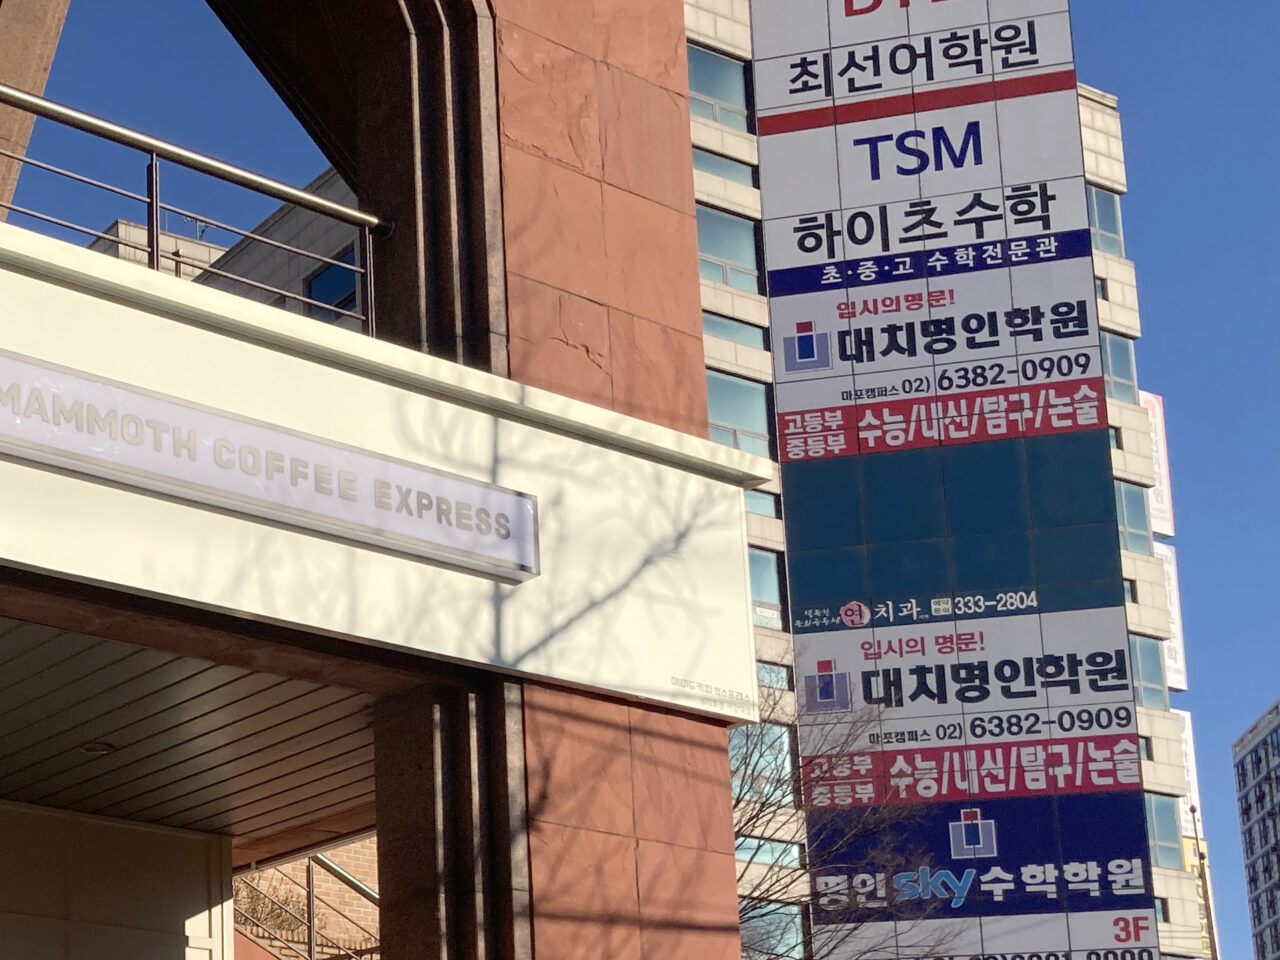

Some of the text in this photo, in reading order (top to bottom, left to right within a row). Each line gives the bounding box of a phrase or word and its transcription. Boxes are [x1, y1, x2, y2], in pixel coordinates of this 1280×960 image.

[788, 20, 1040, 98] 최선어학원
[853, 120, 983, 182] TSM
[793, 183, 1057, 260] 하이츠수학
[927, 236, 1059, 272] 수학전문관
[838, 300, 1090, 364] 대치명인학원
[841, 384, 900, 401] 마포캠퍼스
[937, 352, 1091, 392] 6382-0909
[783, 410, 845, 434] 고등부
[786, 434, 847, 459] 중등부
[213, 437, 358, 502] COFFEE
[374, 479, 512, 540] EXPRESS
[954, 591, 1039, 615] 333-2804
[860, 631, 986, 661] 입시의 명문!
[861, 648, 1129, 708] 대치명인학원
[970, 705, 1132, 738] 6382-0909
[810, 755, 872, 778] 고등부
[1112, 916, 1150, 943] 3F
